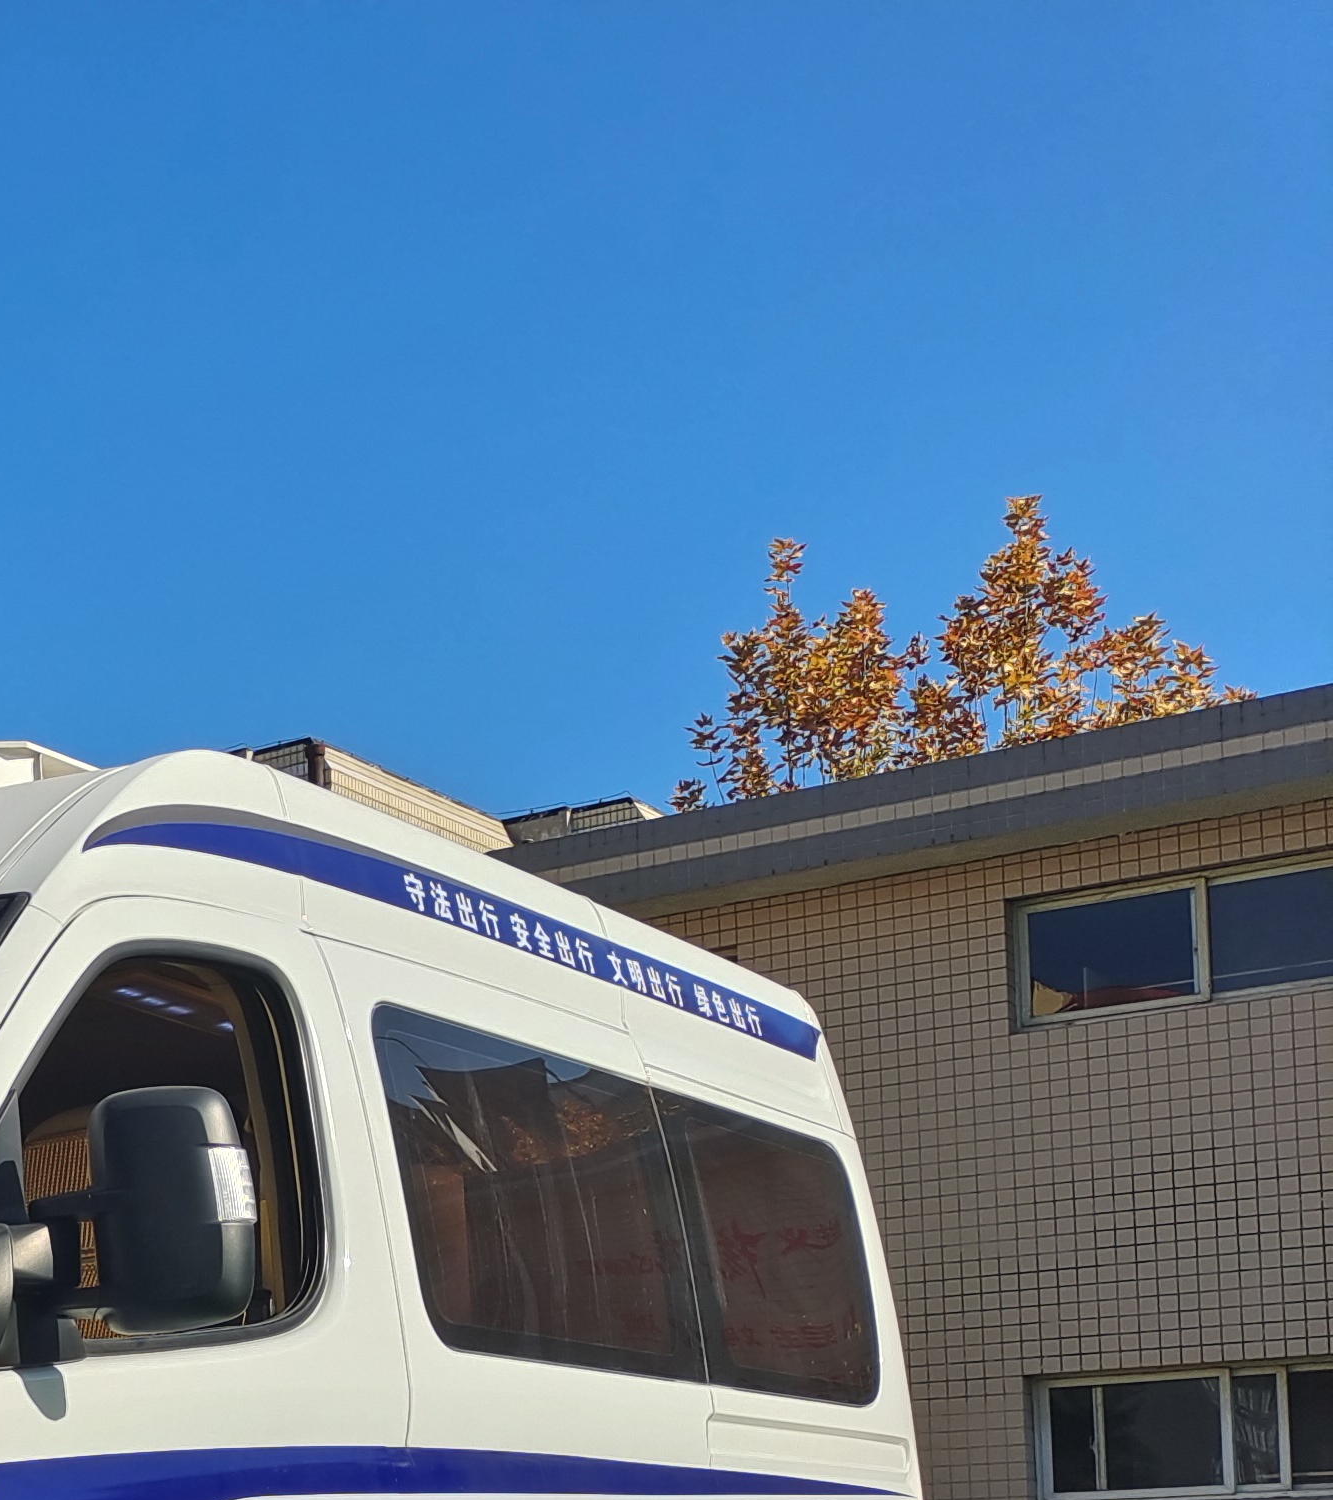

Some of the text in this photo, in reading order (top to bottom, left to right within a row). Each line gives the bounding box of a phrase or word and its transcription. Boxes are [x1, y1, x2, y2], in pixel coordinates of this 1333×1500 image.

[402, 873, 763, 1037] 守法出行 安全出行 文明出行 绿色出行
